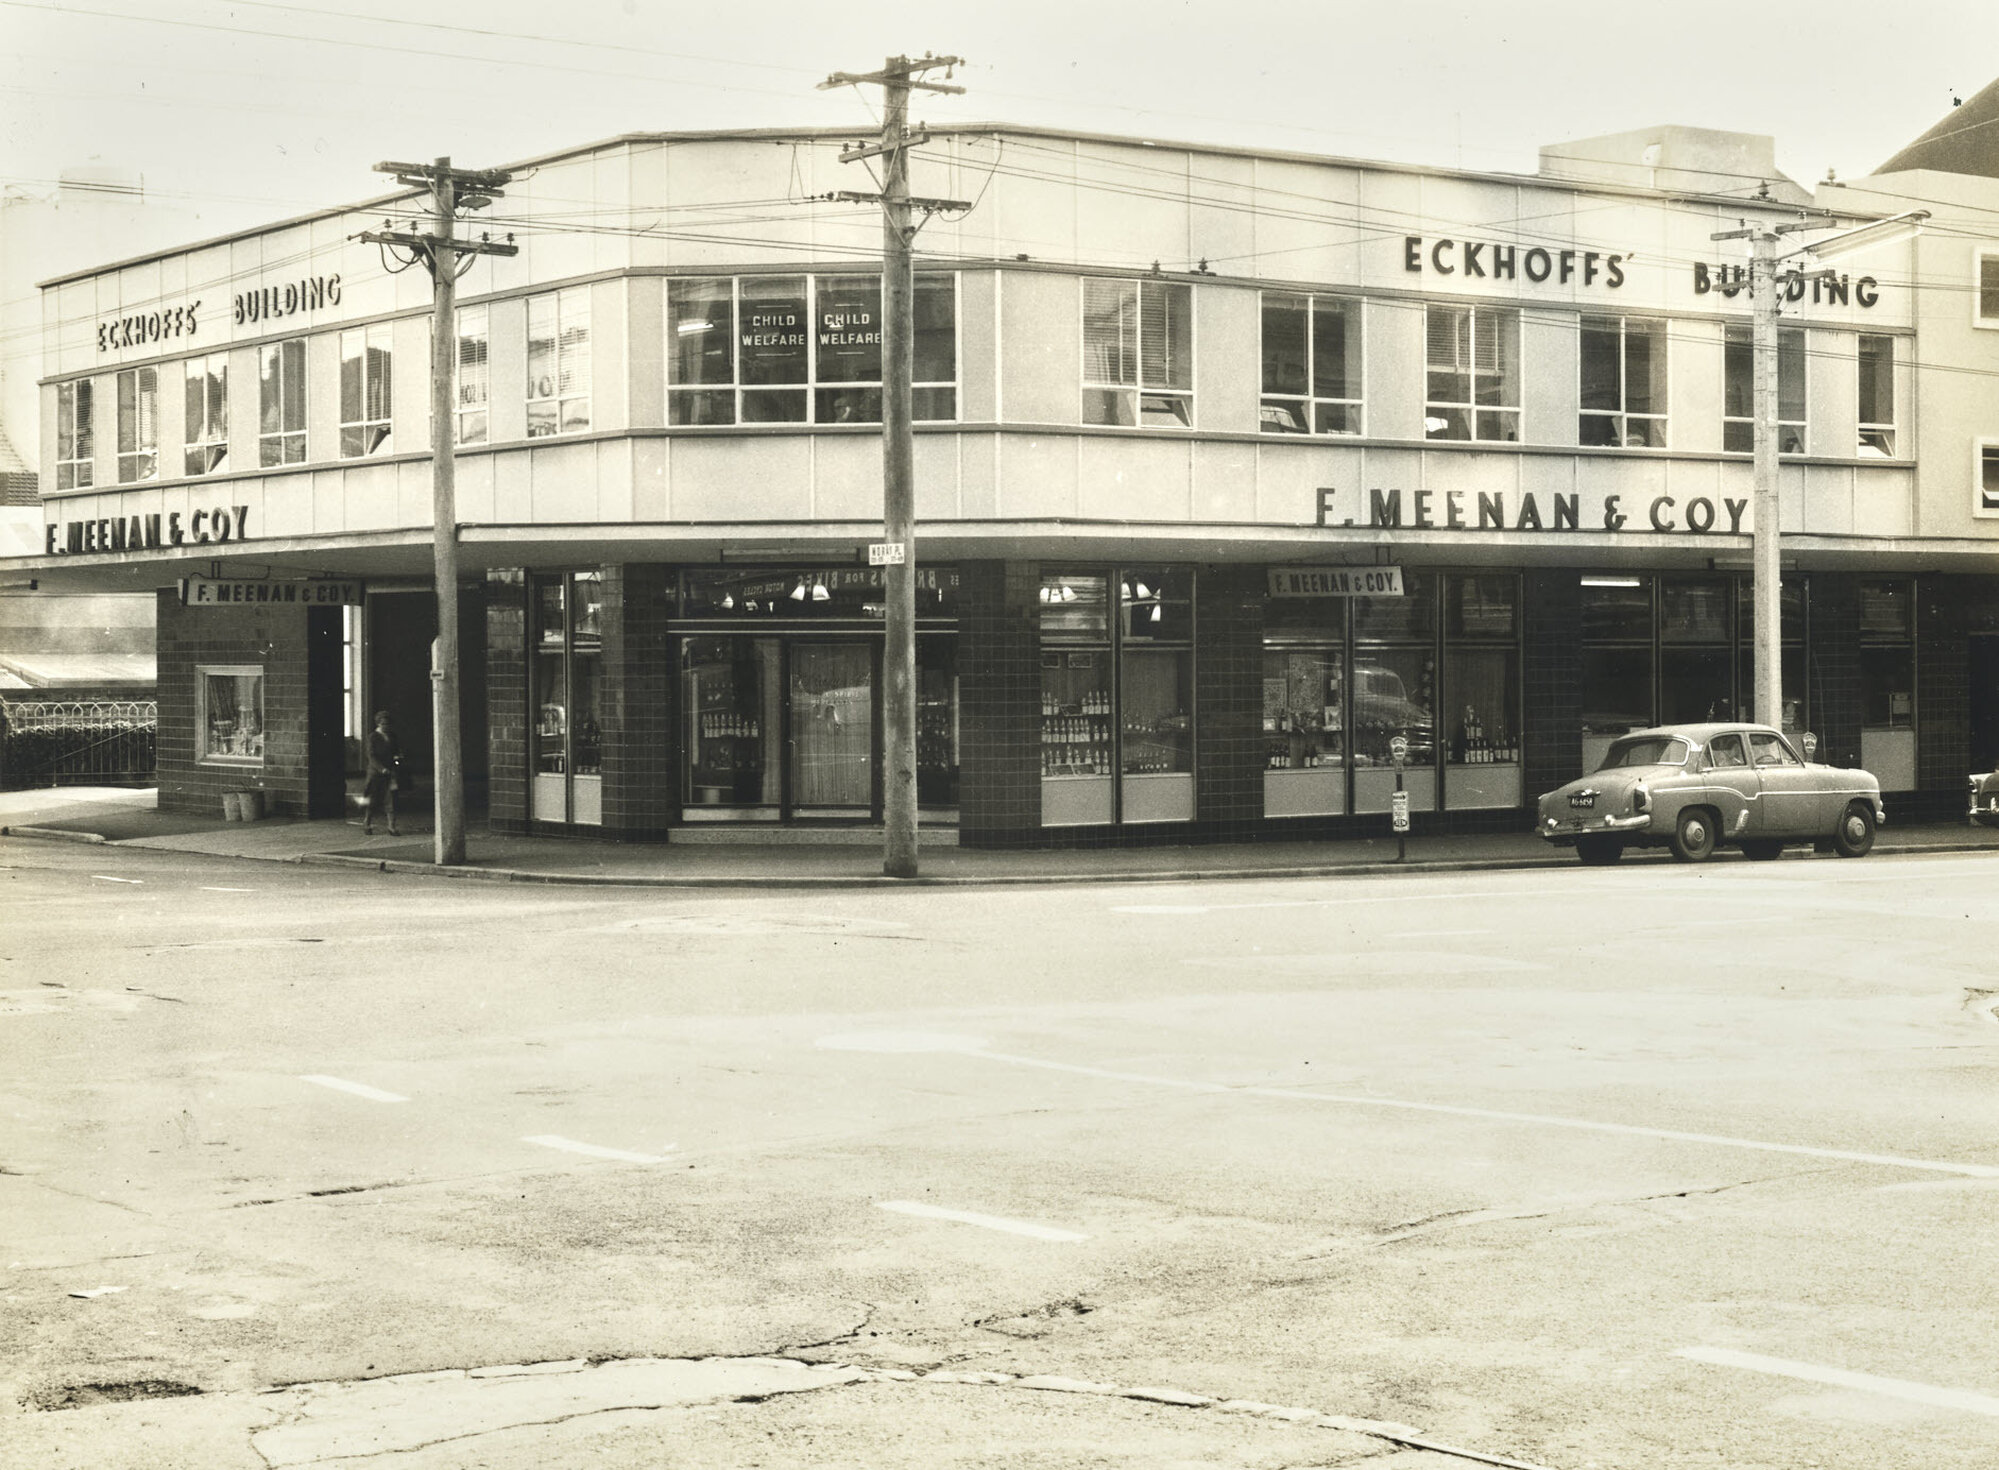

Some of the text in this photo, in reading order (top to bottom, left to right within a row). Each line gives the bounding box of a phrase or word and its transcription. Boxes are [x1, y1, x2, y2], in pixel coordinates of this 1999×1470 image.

[1694, 262, 1879, 308] BUIDING
[235, 273, 341, 324] BUILDING
[753, 315, 795, 326] CHILD
[824, 313, 870, 325] CHILD
[742, 334, 805, 346] WELFARE
[820, 333, 881, 345] WELFARE
[1316, 487, 1748, 532] F. MEENAN & COY
[68, 513, 161, 553] MEENAN
[170, 512, 185, 545] &
[192, 505, 249, 543] COY
[1275, 572, 1398, 592] F. MEENAN & COY.
[198, 584, 210, 602] F.
[217, 584, 296, 602] MEENAN
[302, 588, 311, 602] &
